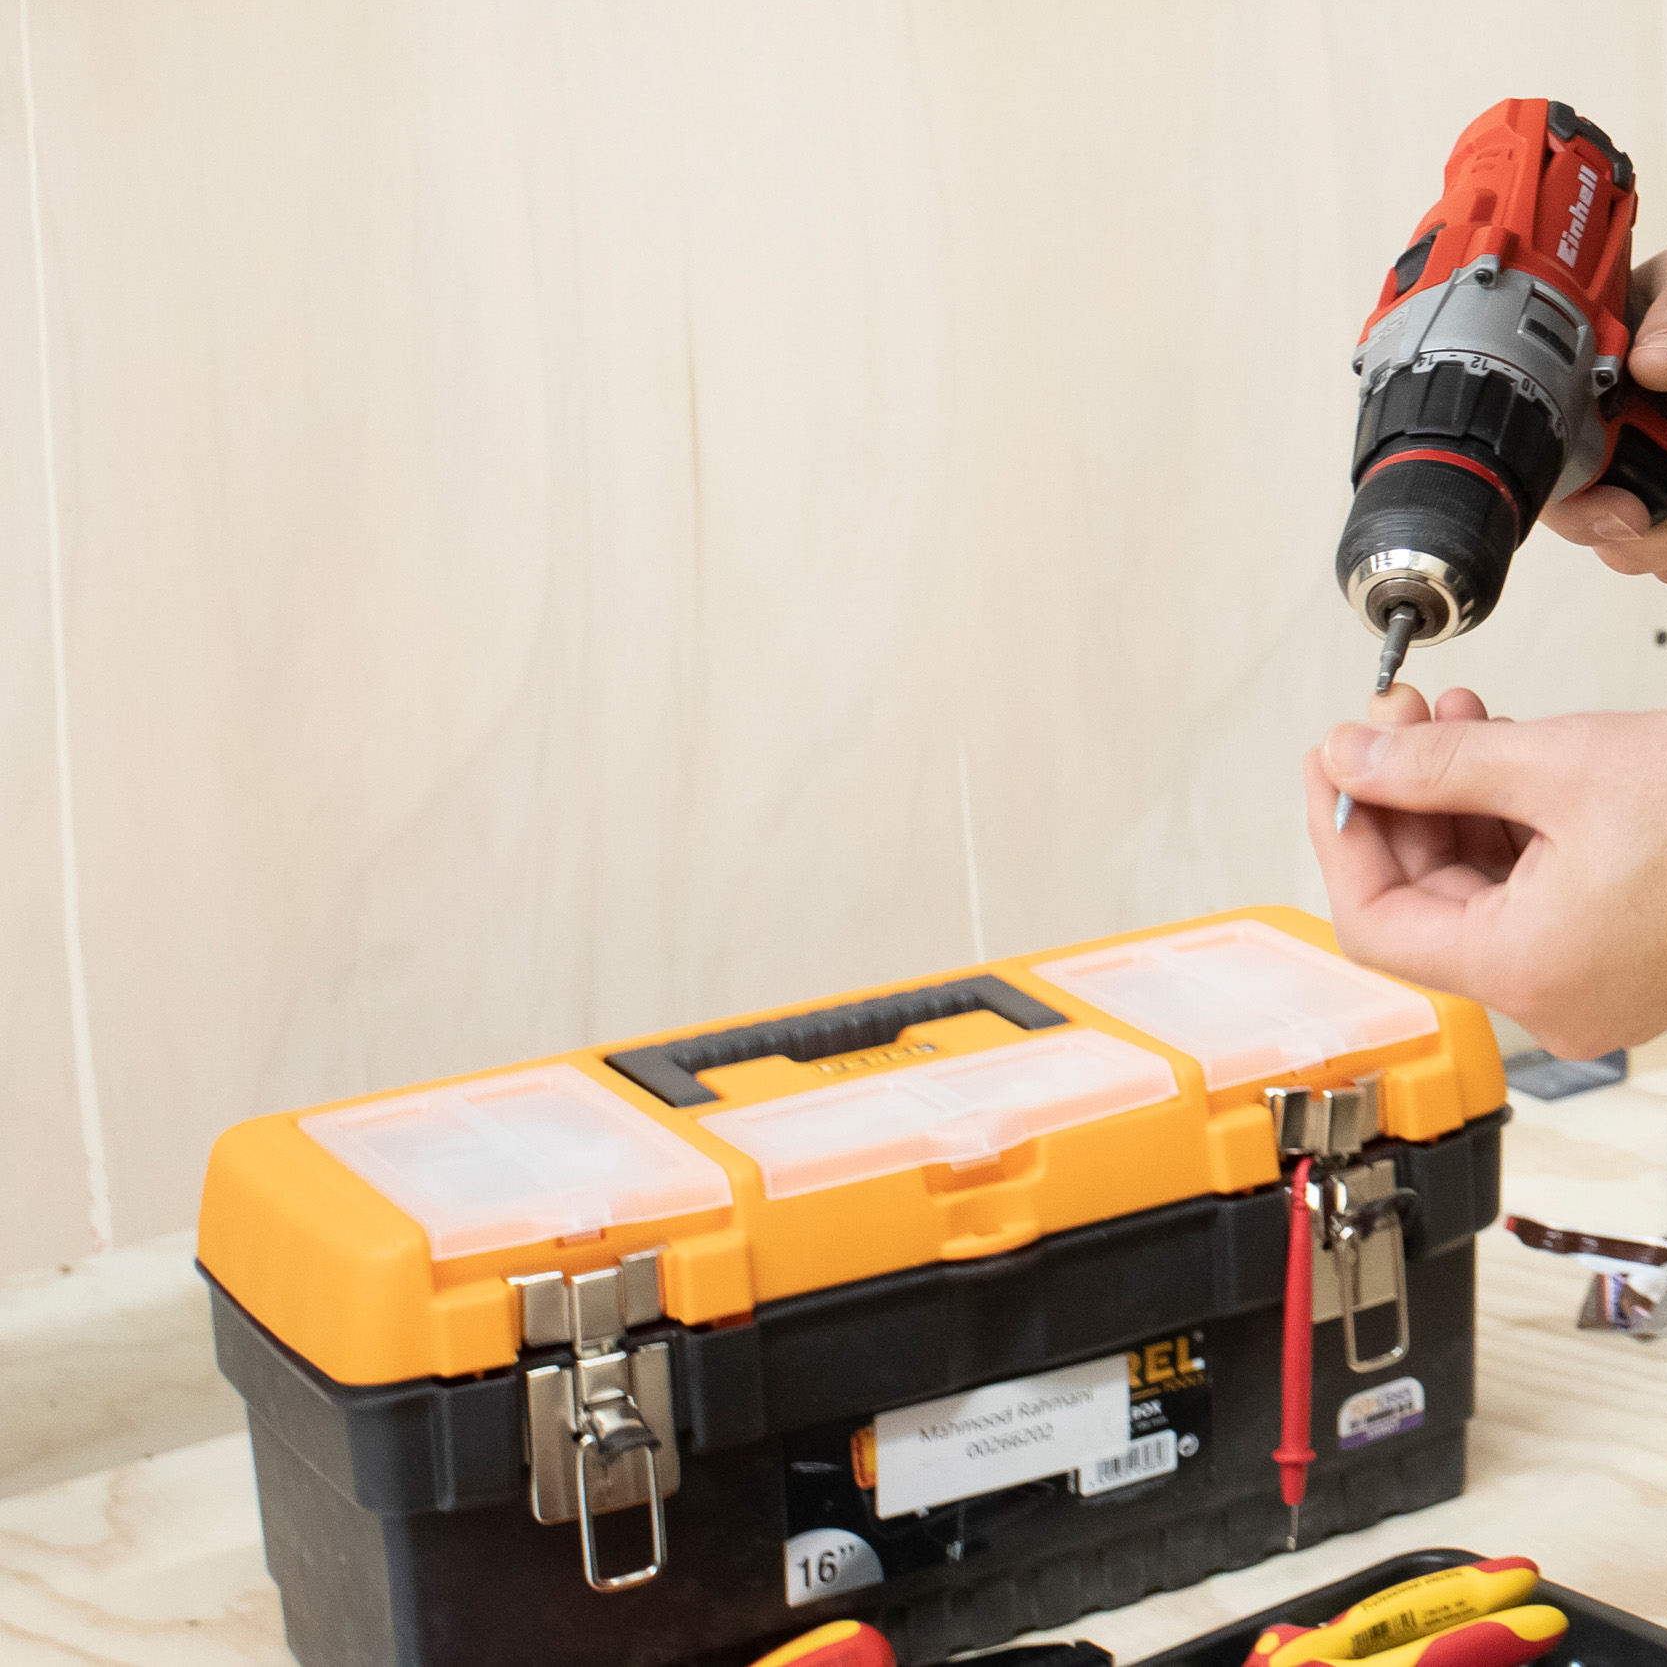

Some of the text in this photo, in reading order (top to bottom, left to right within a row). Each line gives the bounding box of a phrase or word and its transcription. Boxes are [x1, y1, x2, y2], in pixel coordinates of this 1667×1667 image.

[1557, 164, 1599, 269] Einhell
[1471, 355, 1489, 371] 12
[1521, 377, 1537, 397] 10
